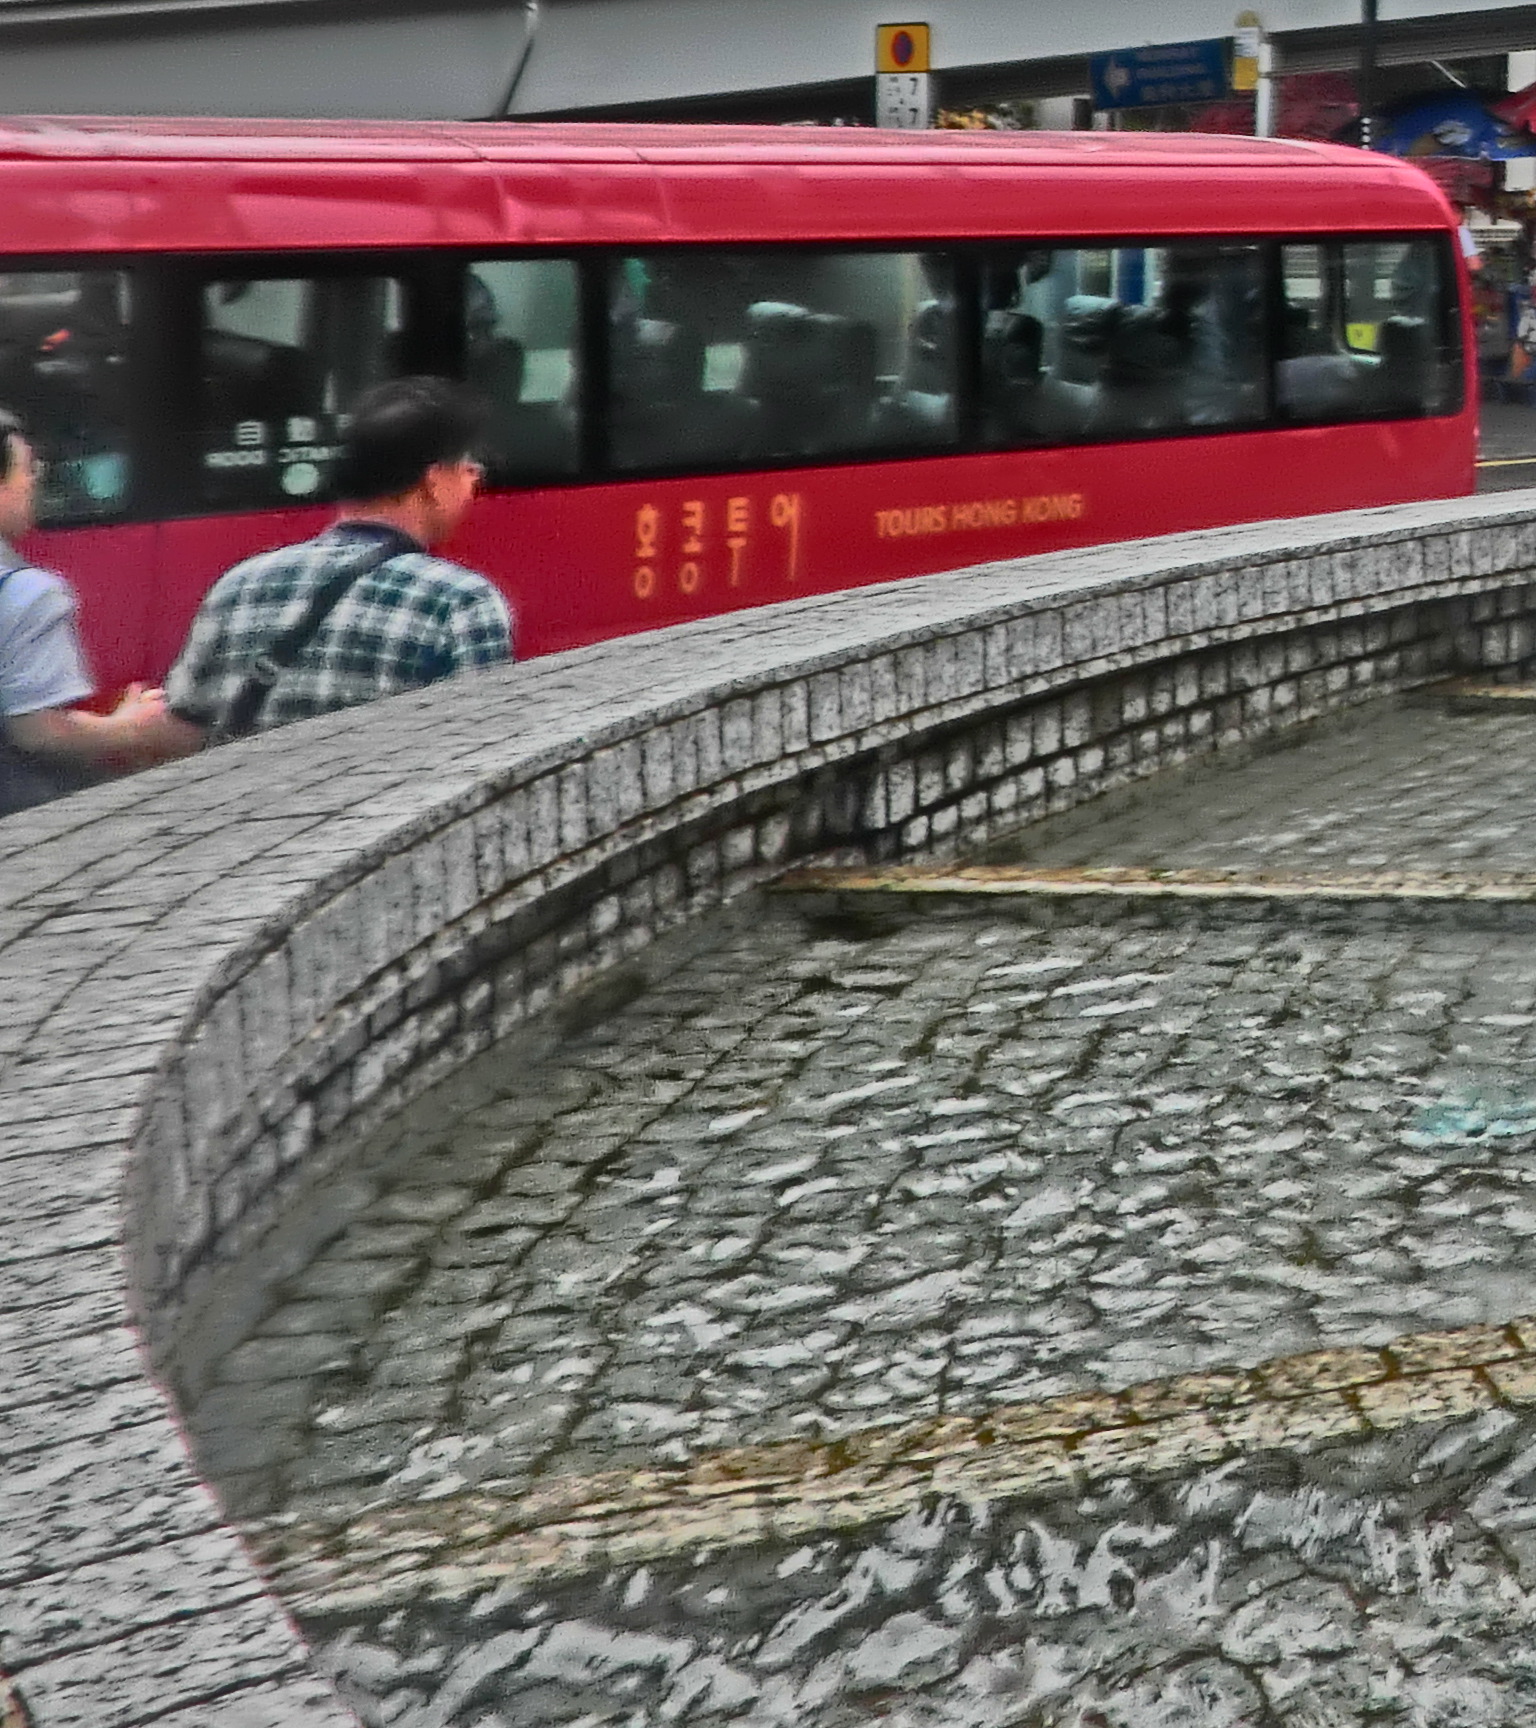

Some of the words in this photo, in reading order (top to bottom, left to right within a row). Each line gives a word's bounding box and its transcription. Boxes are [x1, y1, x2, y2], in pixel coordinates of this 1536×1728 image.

[633, 491, 801, 599] 홍콩투어
[874, 506, 947, 538] TOURS
[951, 499, 1018, 531] HONG
[1022, 493, 1083, 523] KONG
